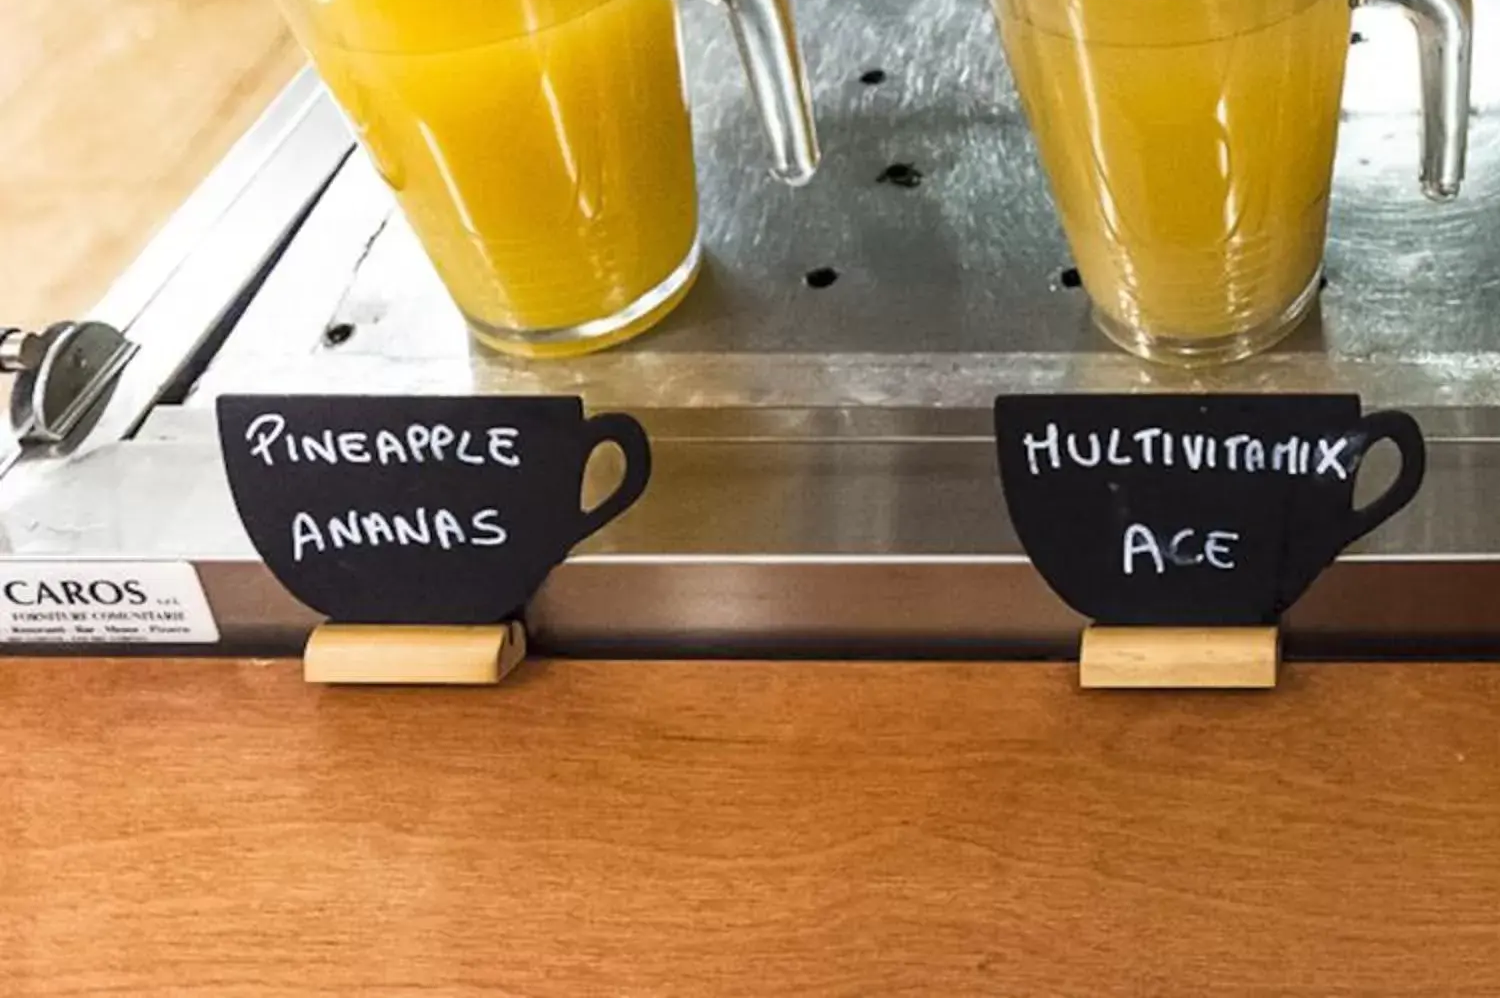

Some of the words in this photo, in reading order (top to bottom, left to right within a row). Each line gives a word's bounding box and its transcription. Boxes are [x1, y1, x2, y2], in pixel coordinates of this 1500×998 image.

[245, 413, 521, 466] PINEAPPLE
[1024, 423, 1347, 479] MULTIVITAMIX
[292, 507, 507, 561] ANANAS
[1123, 523, 1239, 573] ACE
[4, 579, 147, 605] CAROS
